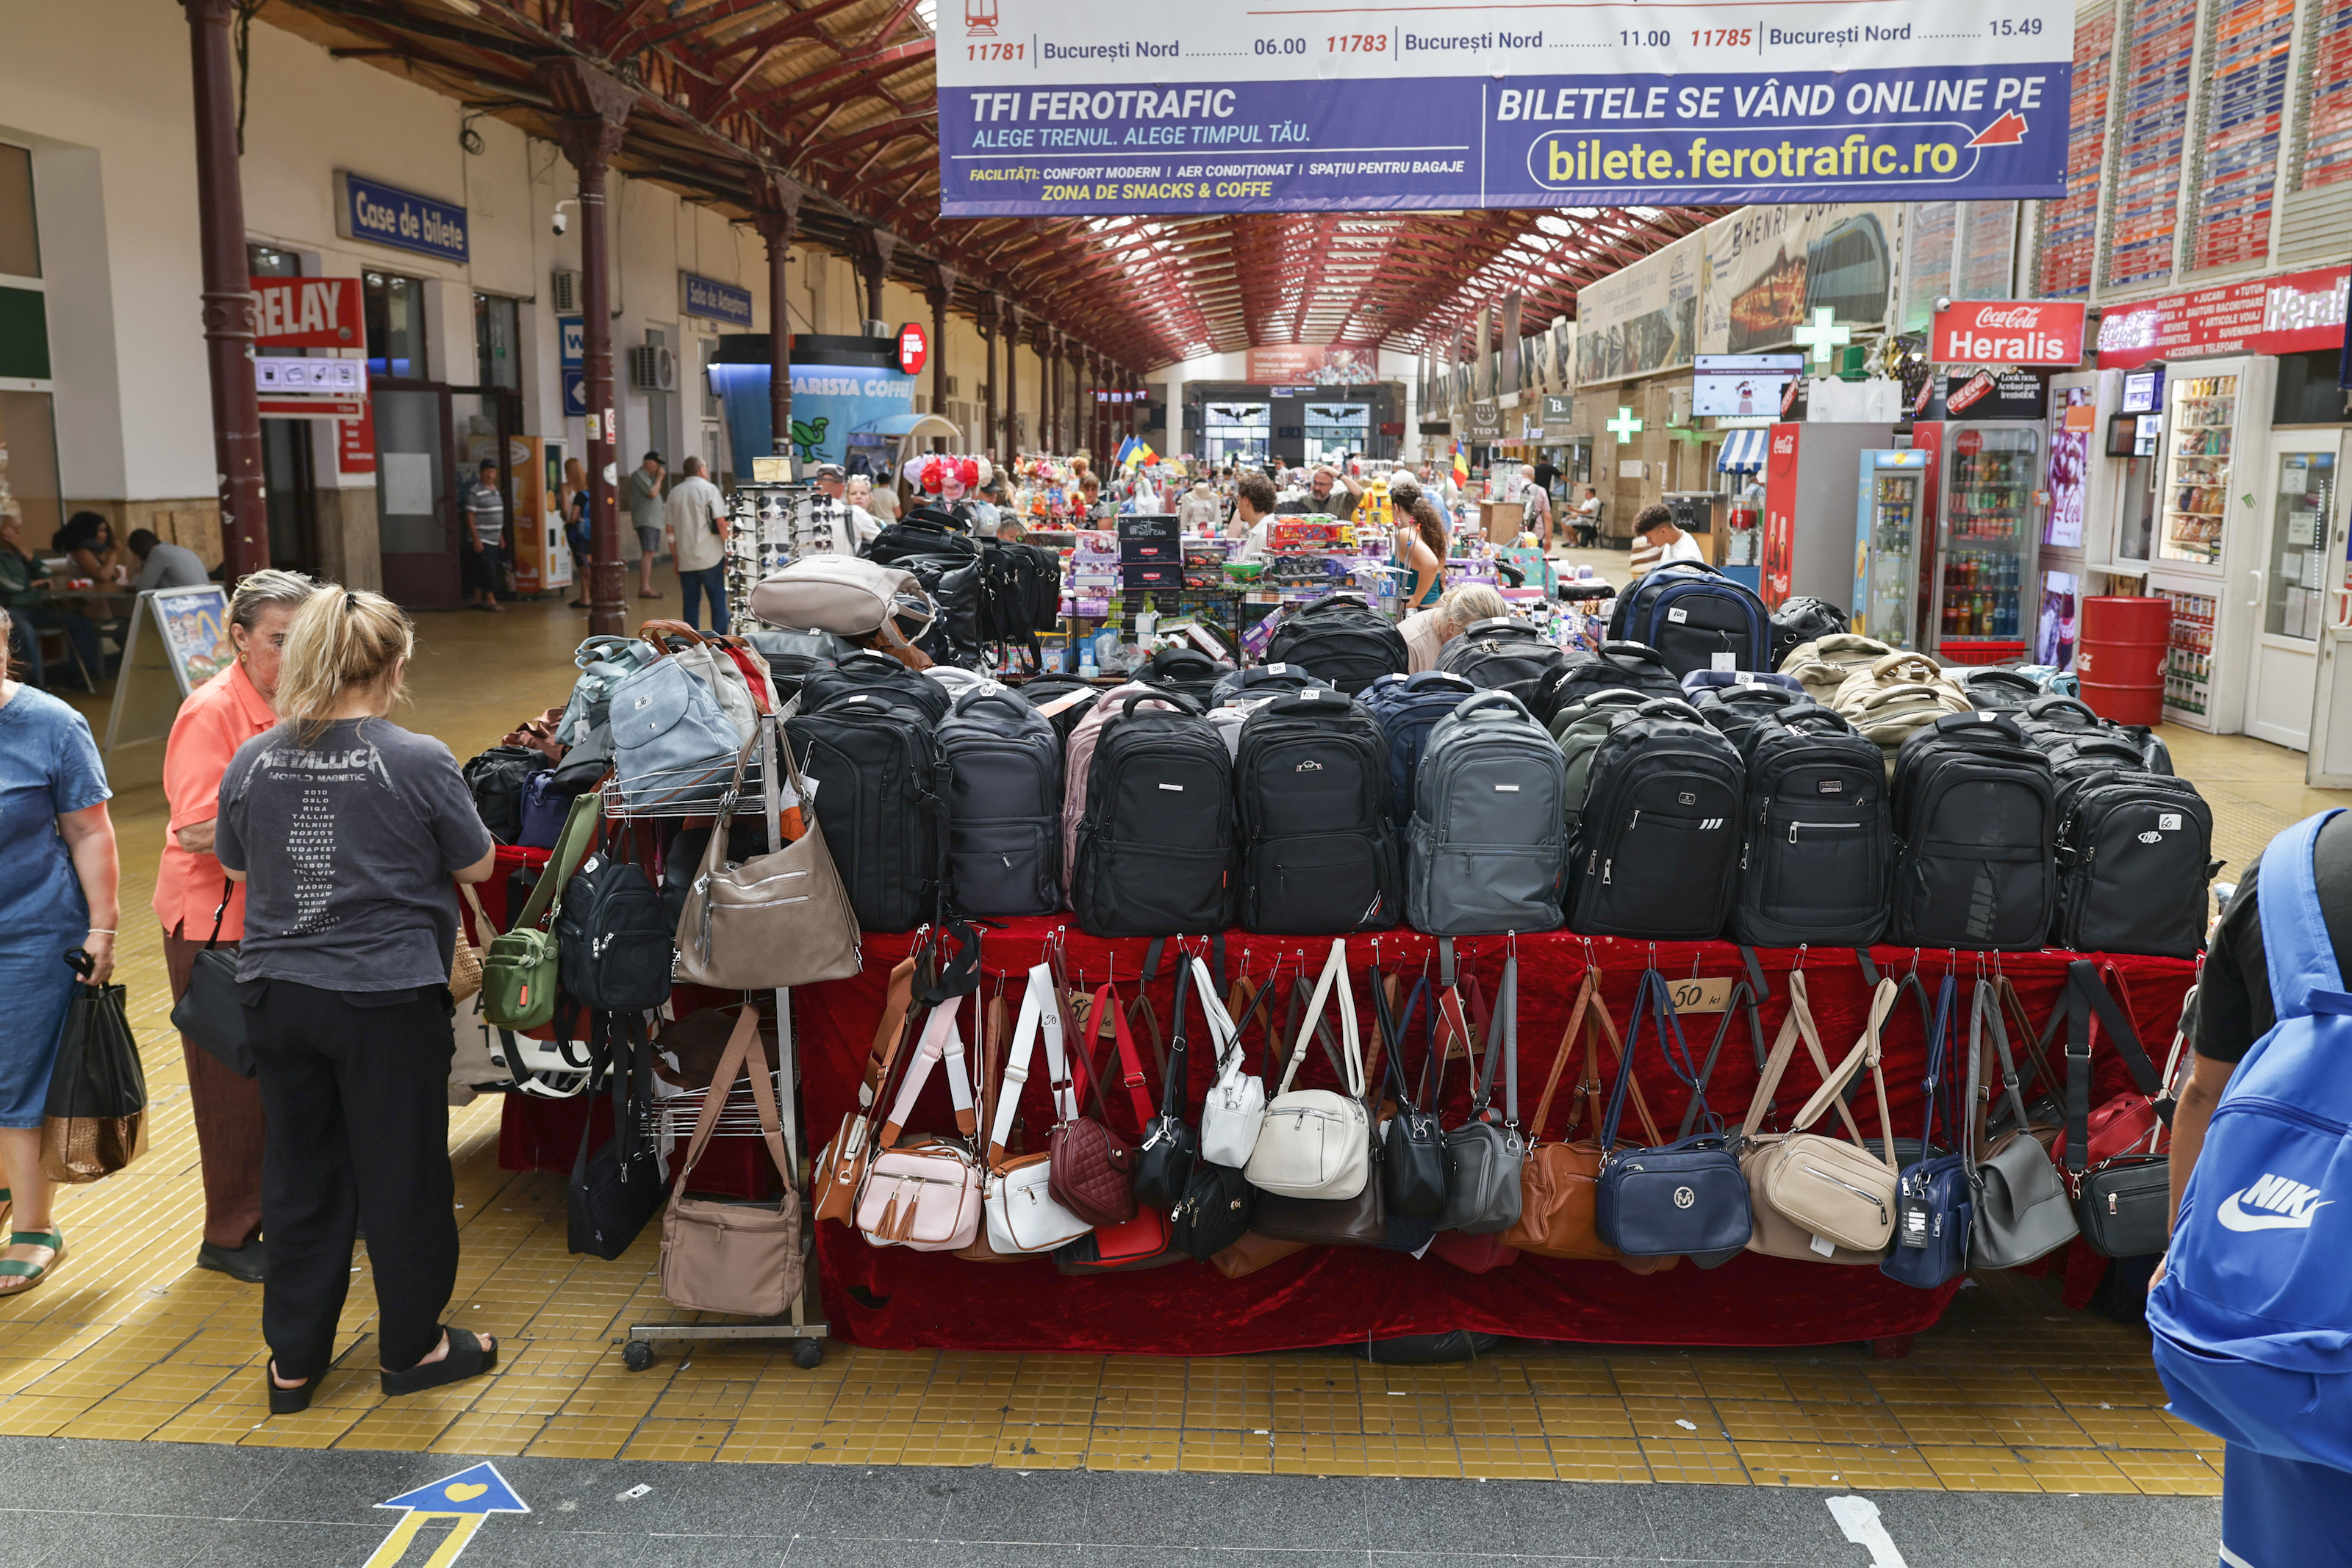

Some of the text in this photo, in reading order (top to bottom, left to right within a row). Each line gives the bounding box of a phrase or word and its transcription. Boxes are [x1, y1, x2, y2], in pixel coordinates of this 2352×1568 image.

[1405, 30, 1671, 54] București Nord 11.00
[1690, 29, 1752, 47] 11785
[1769, 18, 2043, 47] București Nord 15.49
[967, 43, 1025, 62] 11781
[1044, 37, 1307, 64] București Nord 06.00
[1326, 35, 1387, 53] 11783
[970, 89, 1236, 122] TFI FEROTRAFIC
[1497, 75, 2046, 121] BILETELE SE VÂND ONLINE PE
[972, 120, 1311, 148] ALEGE TRENUL. ALEGE TIMPUL TĂU.
[1549, 134, 1959, 181] bilete.ferotrafic.ro
[1043, 166, 1102, 180] CONFORT
[1105, 165, 1161, 179] MODERN
[1177, 165, 1202, 178] AER
[1204, 163, 1294, 179] CONDIȚIONAT
[1309, 162, 1356, 178] SPAȚIU
[1358, 161, 1411, 175] PENTRU
[1413, 159, 1465, 173] BAGAJE
[1041, 181, 1273, 201] ZONA DE SNACKS & COFFE
[356, 190, 464, 251] Case de bilete
[2156, 282, 2265, 310] DULCIURI JUCARII TUTUN
[2186, 303, 2215, 318] BAUTURI
[2216, 295, 2265, 314] RACORITOARE
[252, 281, 342, 337] RELAY
[1975, 306, 2043, 329] Coca-Cola
[2156, 323, 2262, 347] COSMETICE SUVENIRURI
[2163, 321, 2190, 334] REVISTE
[2204, 314, 2238, 328] ARTICOLE
[1948, 331, 2065, 360] Heralis
[2170, 339, 2244, 358] ACCESORII TELEFOANE
[1472, 427, 1499, 436] TED'S
[1739, 674, 1749, 683] 80
[1302, 691, 1318, 699] 100
[238, 738, 401, 801] METALLICA
[317, 772, 367, 783] MAGNETIC
[2161, 816, 2173, 829] 60
[293, 891, 333, 899] WARSAW
[296, 883, 333, 891] MADRID
[298, 899, 328, 907] ZURICH
[1671, 985, 1702, 1008] 50
[1044, 1014, 1057, 1026] 50
